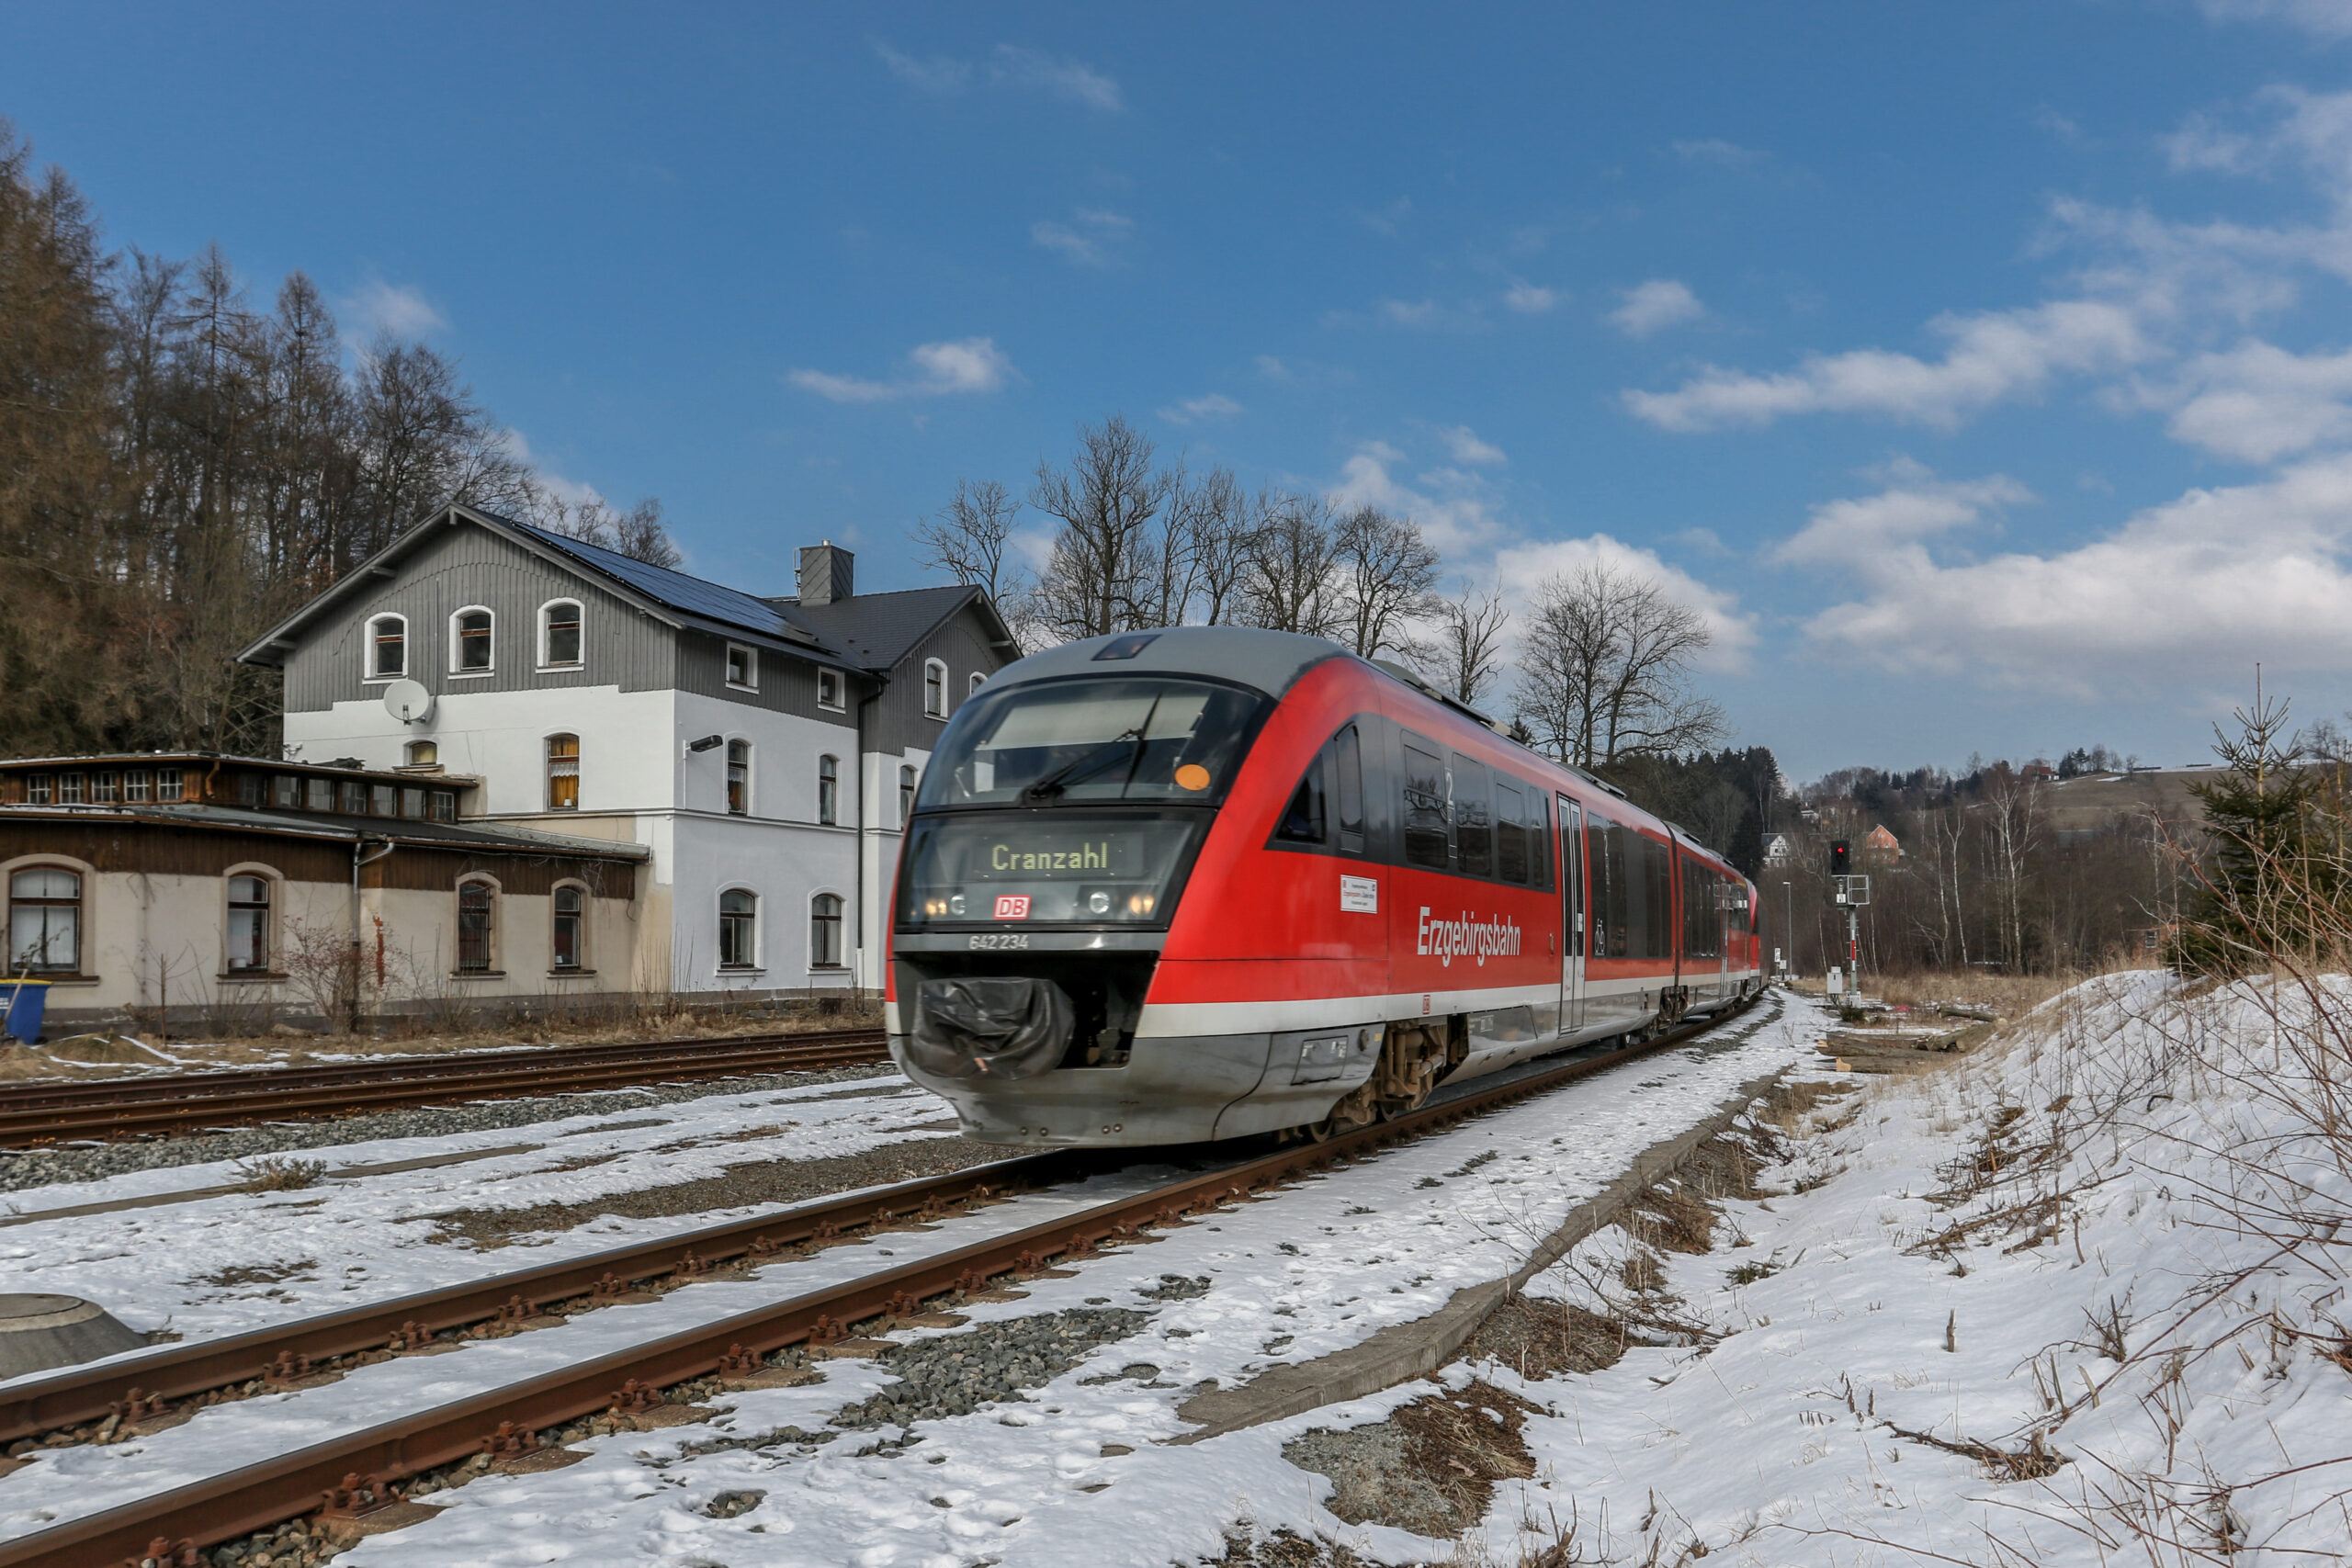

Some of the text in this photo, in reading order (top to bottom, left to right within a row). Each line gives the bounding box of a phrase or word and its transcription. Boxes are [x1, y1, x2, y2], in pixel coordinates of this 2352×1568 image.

[992, 842, 1108, 871] Cranzahl
[998, 898, 1026, 916] DB
[969, 934, 1028, 950] 642 234
[1418, 906, 1521, 967] Erzgebirgsbahn
